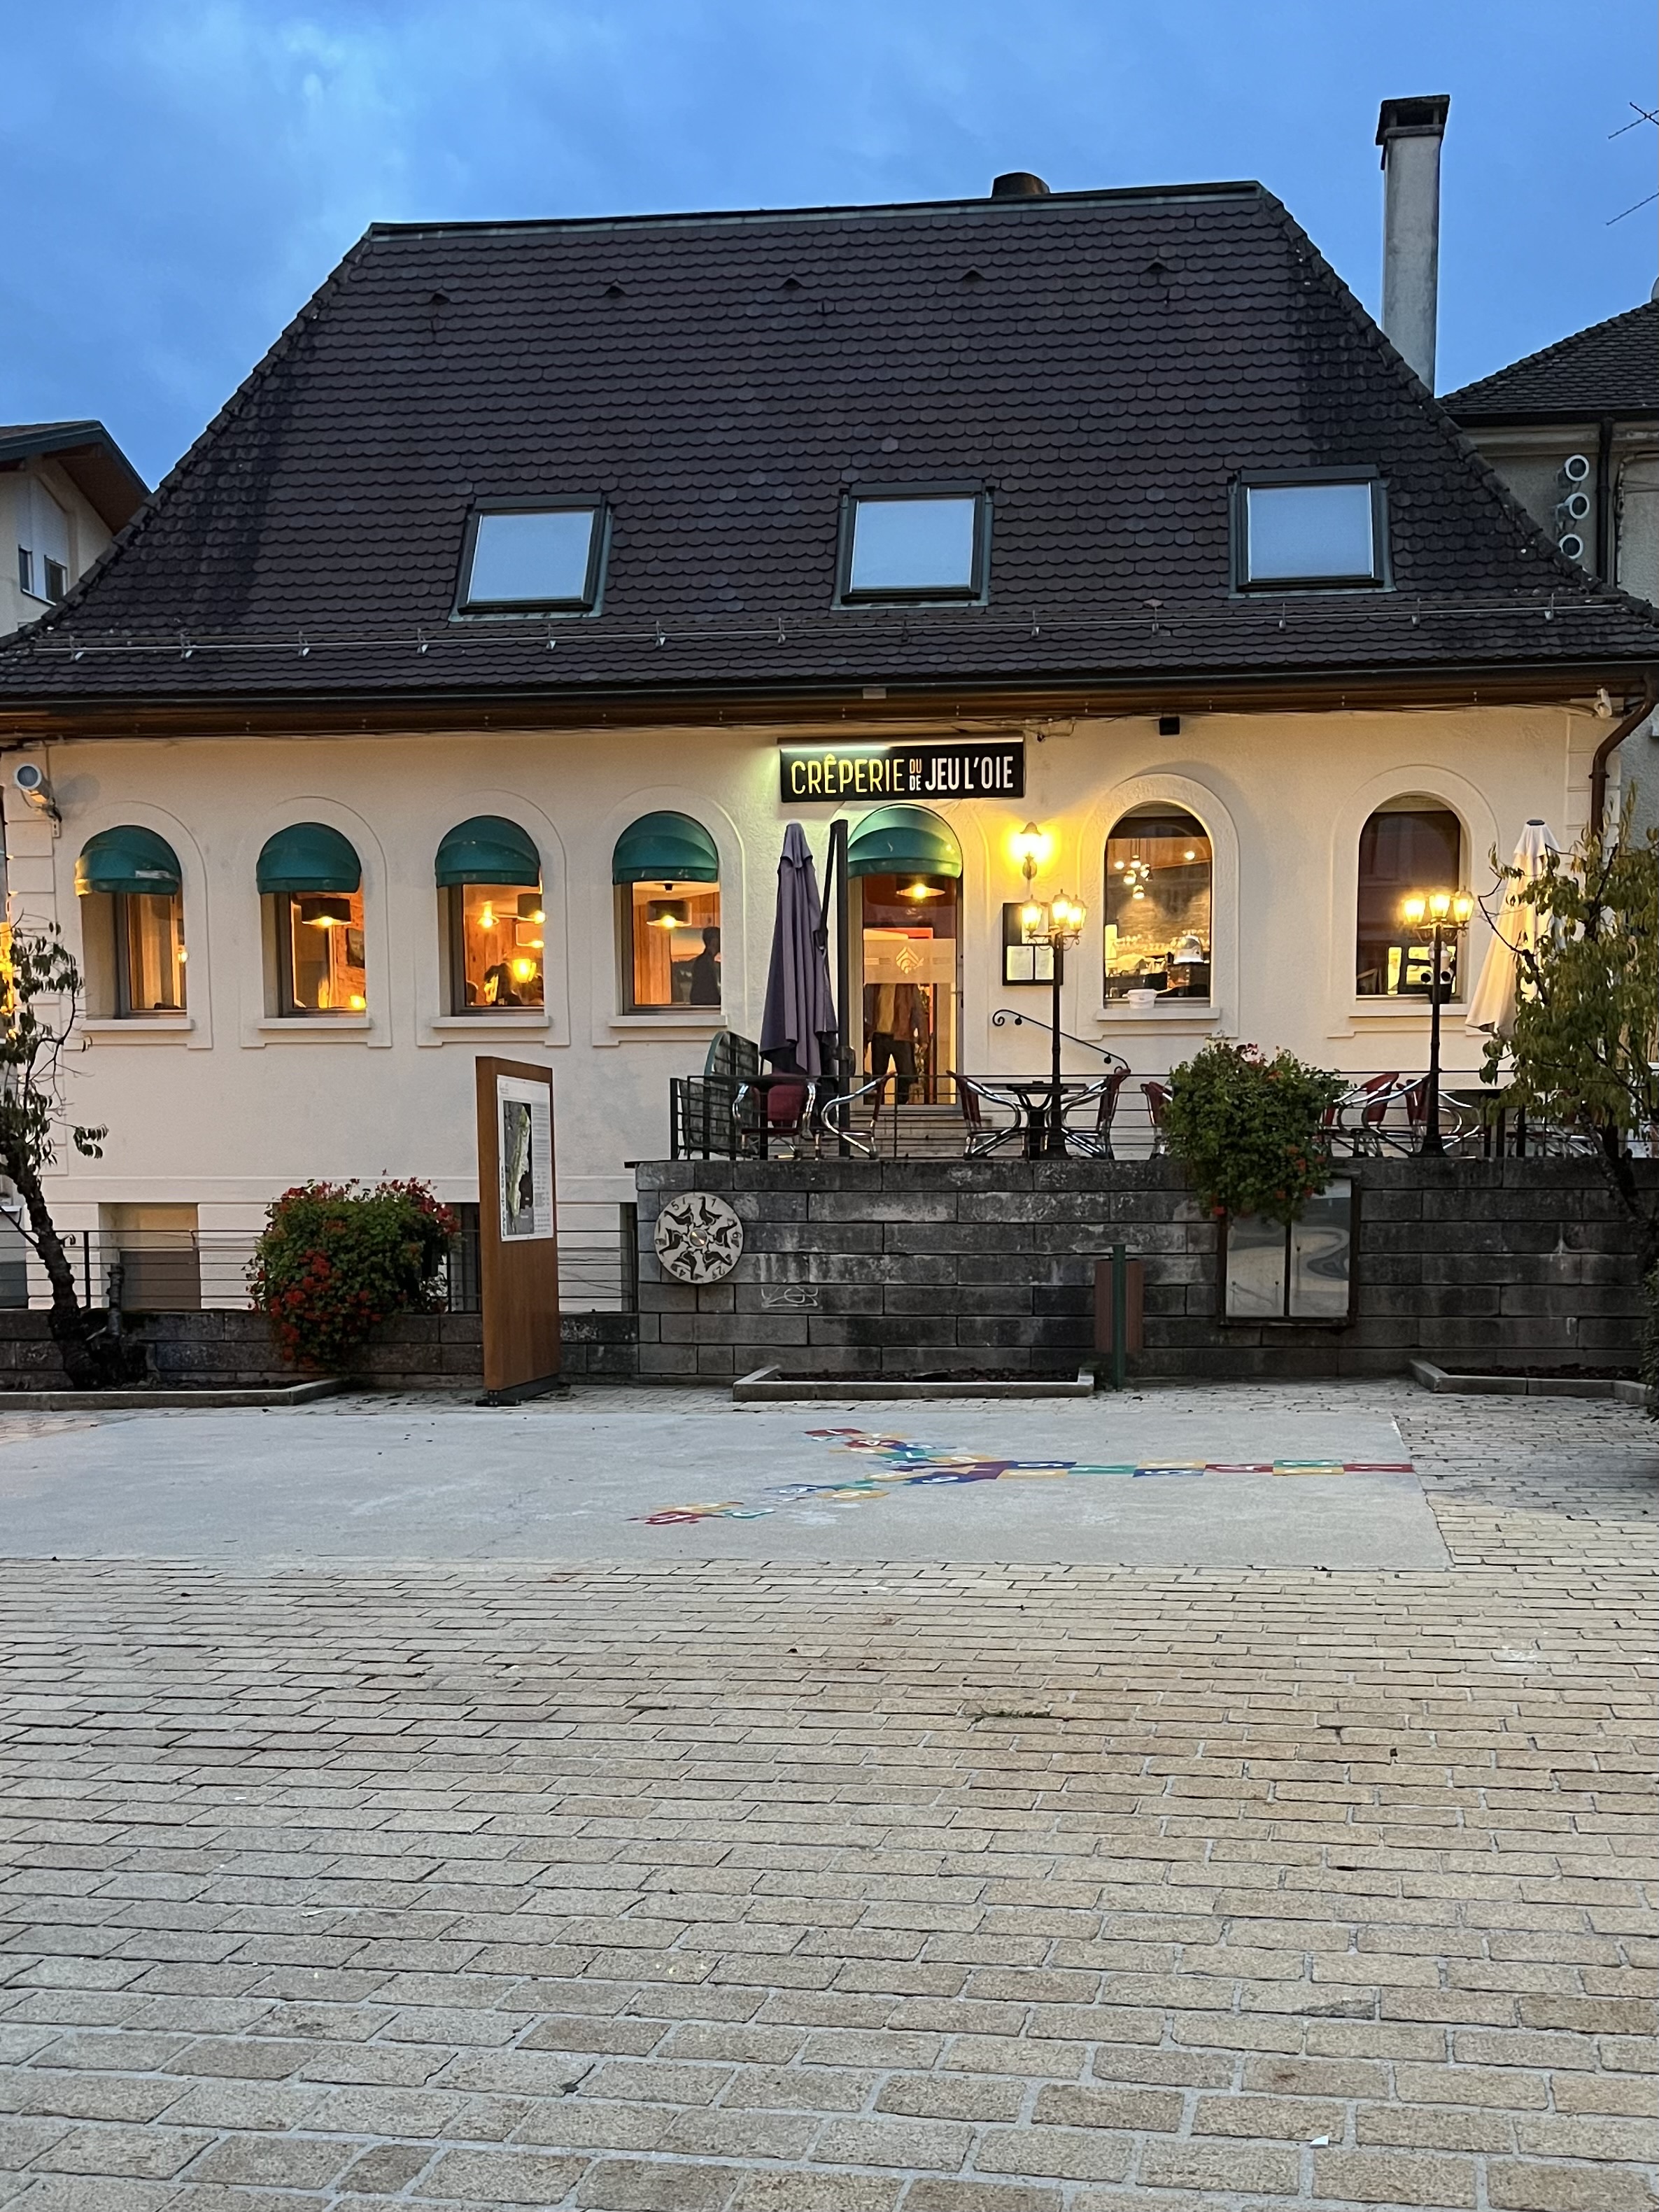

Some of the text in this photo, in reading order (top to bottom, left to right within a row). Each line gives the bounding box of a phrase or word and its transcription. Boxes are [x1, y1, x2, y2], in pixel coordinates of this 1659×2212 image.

[791, 754, 905, 794] CRÊPERIE
[909, 775, 922, 791] DE
[925, 758, 960, 791] JEU
[964, 756, 1014, 789] L'OIE
[671, 1201, 679, 1211] 5
